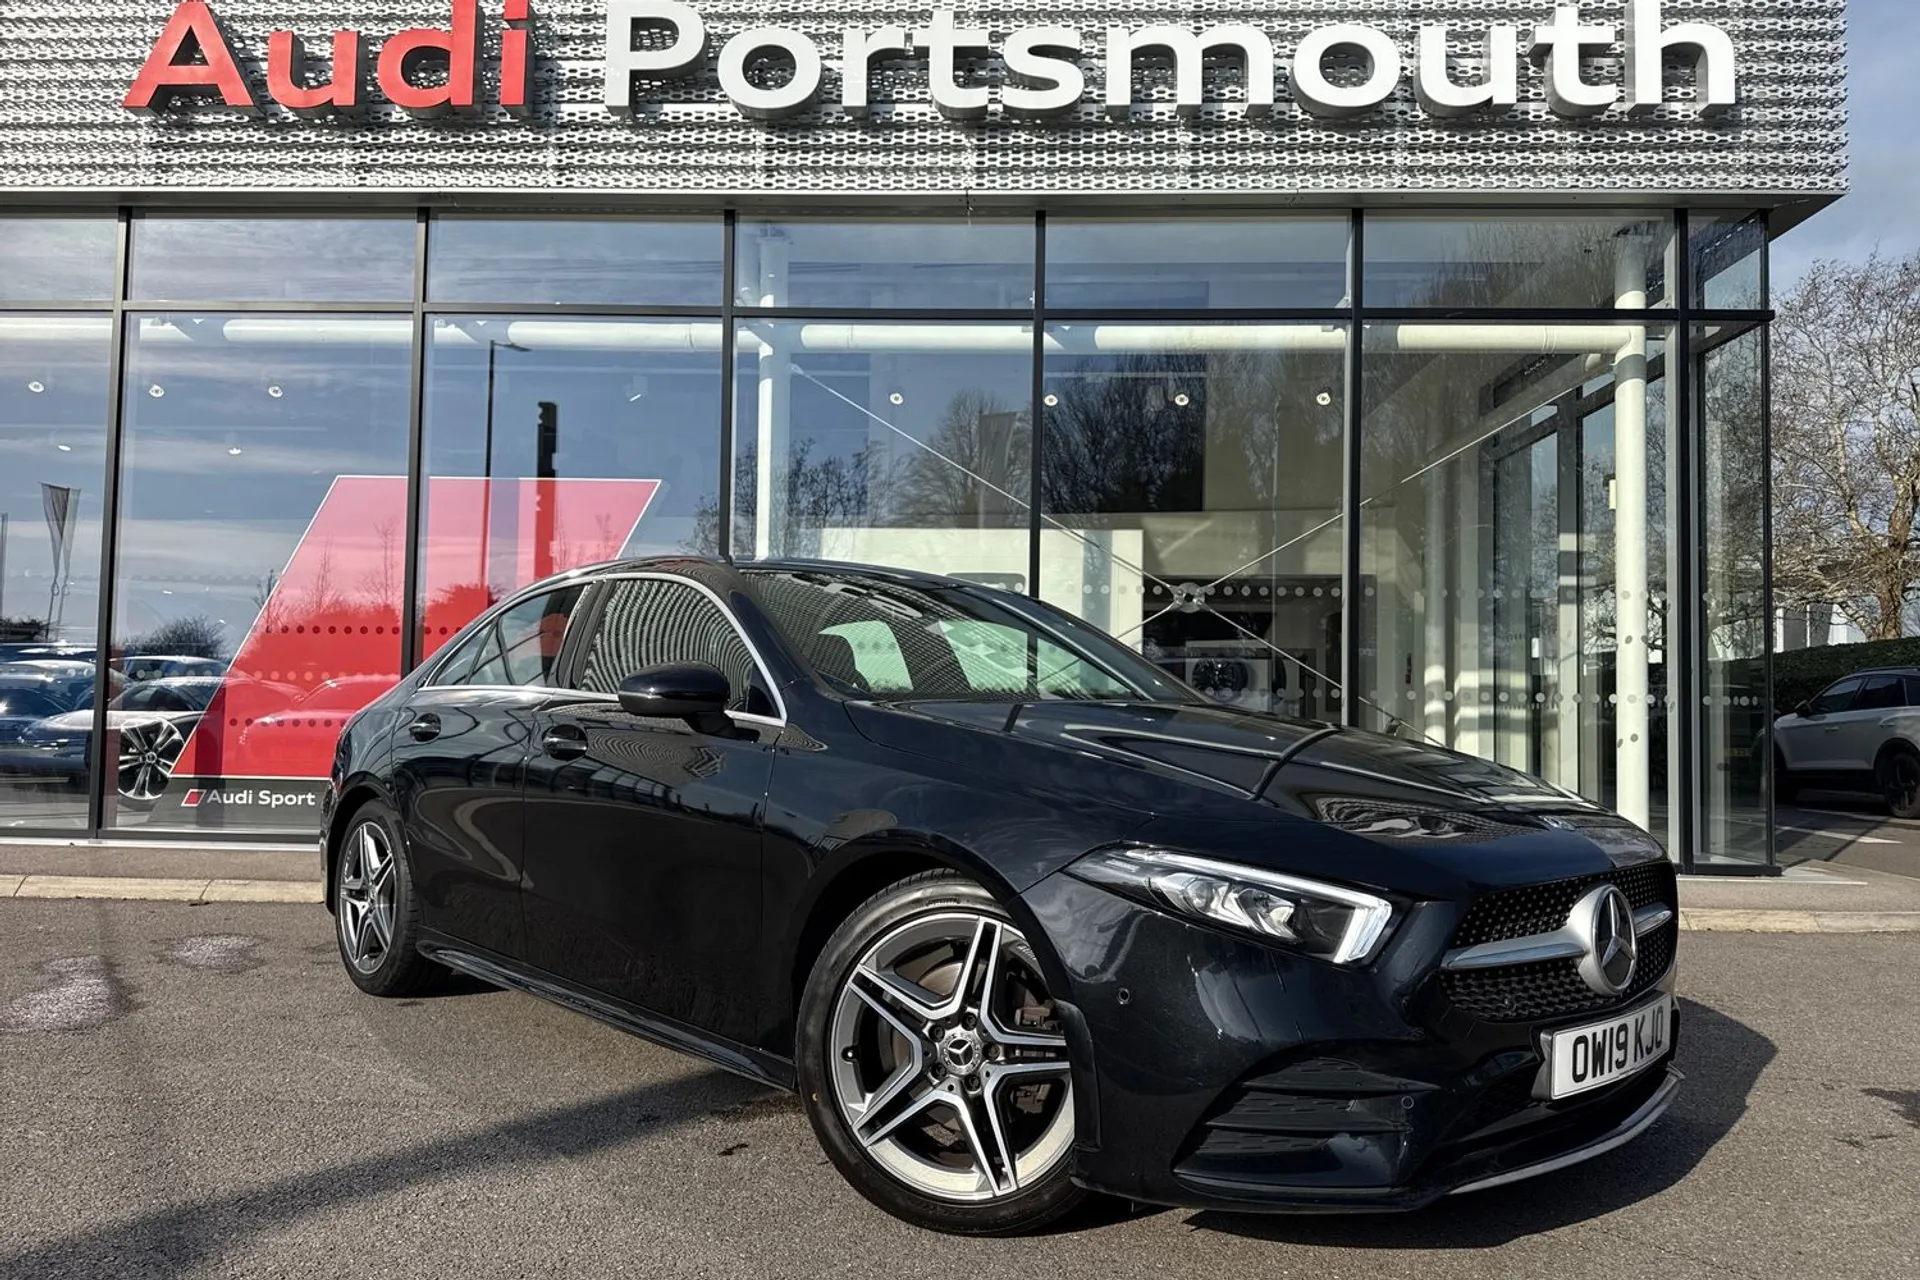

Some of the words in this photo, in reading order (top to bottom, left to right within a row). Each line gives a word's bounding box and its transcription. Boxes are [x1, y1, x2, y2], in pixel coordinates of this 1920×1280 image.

[122, 0, 530, 112] Audi
[604, 0, 1737, 112] Portsmouth
[208, 789, 253, 804] Audi
[258, 790, 315, 808] Sport
[1572, 1023, 1628, 1083] OW19
[1634, 1005, 1663, 1062] KJO
